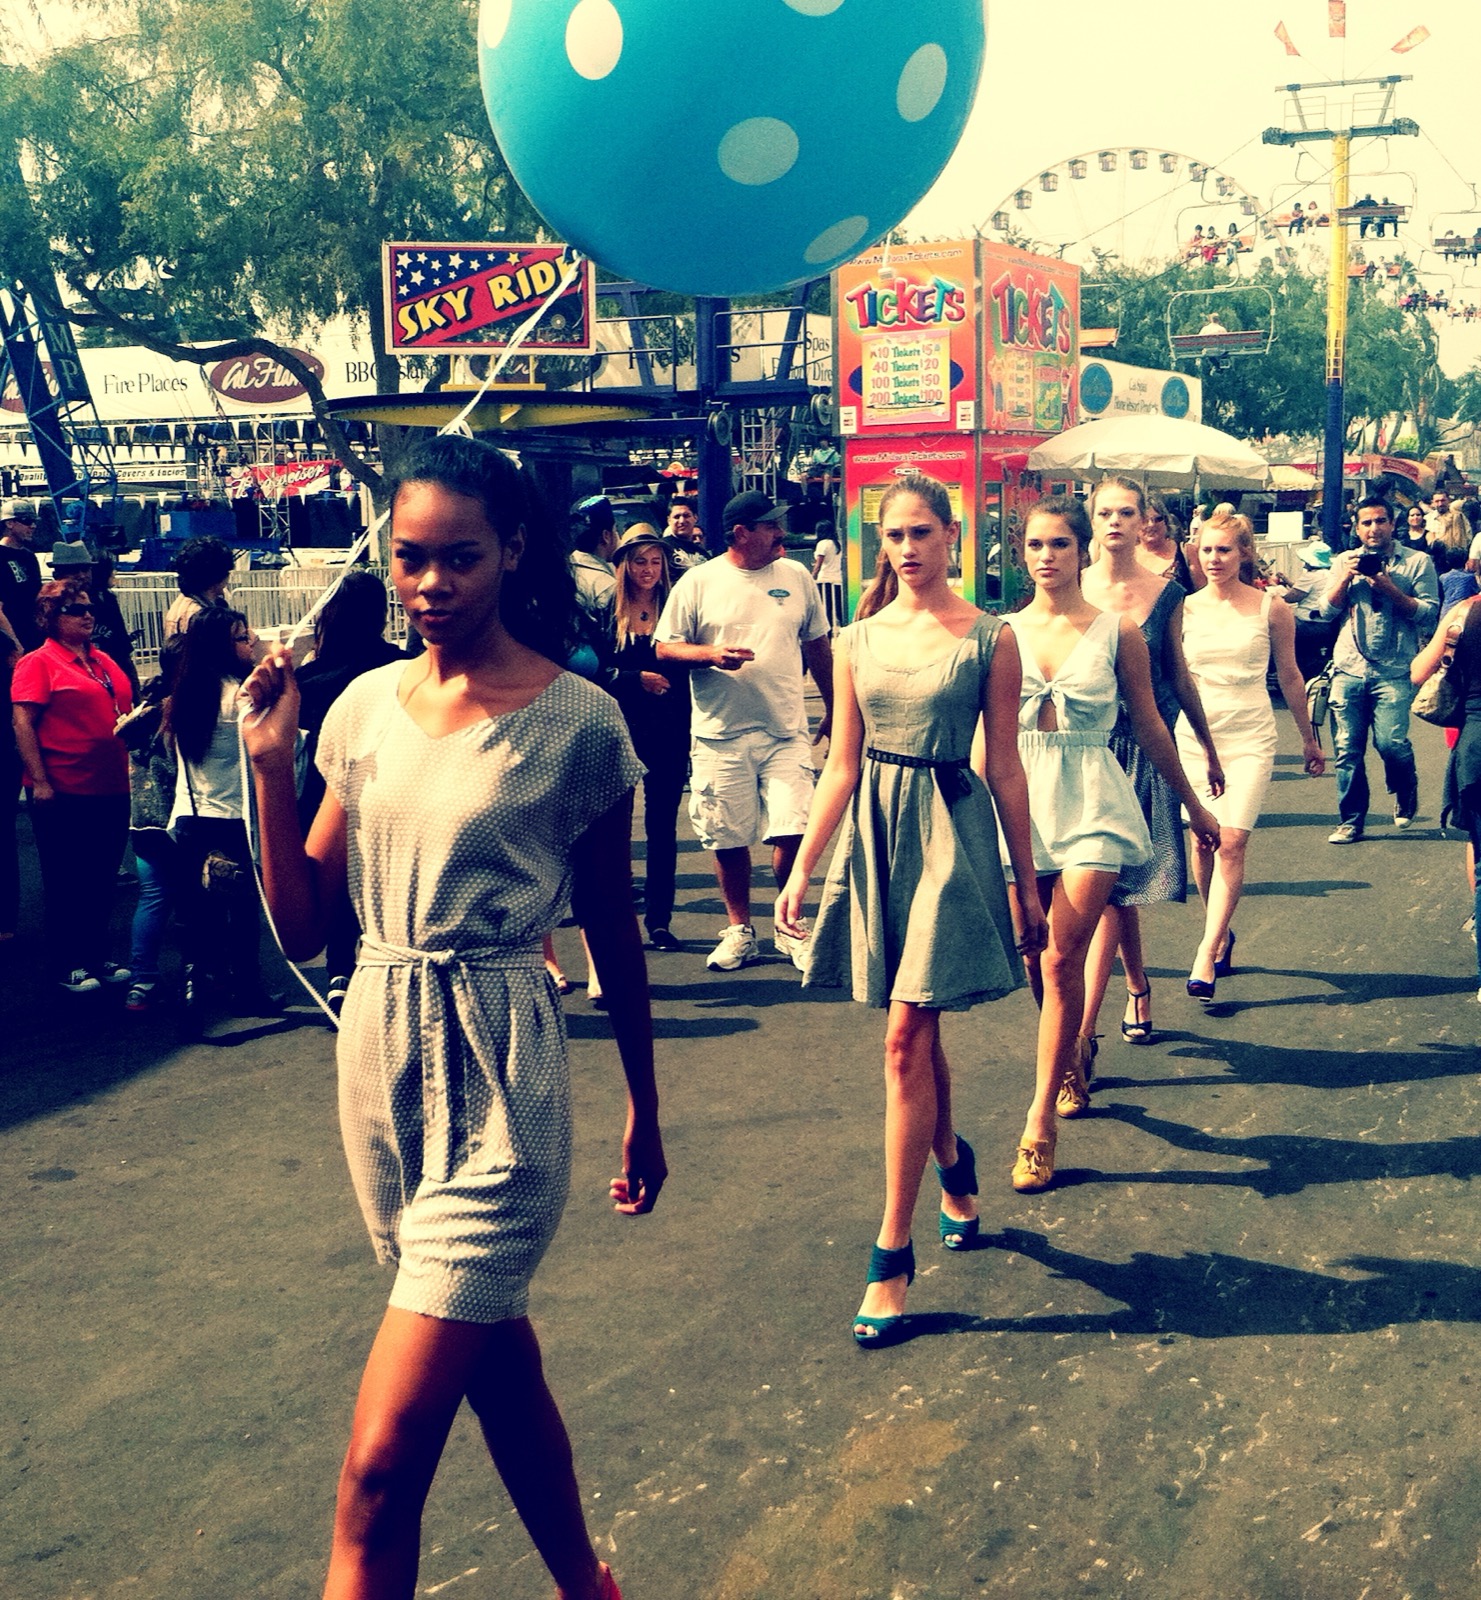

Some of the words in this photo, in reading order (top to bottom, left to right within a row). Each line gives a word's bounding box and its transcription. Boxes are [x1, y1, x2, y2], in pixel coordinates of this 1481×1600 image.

[397, 286, 472, 342] SKY
[846, 276, 966, 329] TICKETS
[991, 272, 1070, 354] TICKETS
[805, 330, 831, 358] Spas
[103, 373, 135, 394] Fire
[138, 372, 188, 393] Places
